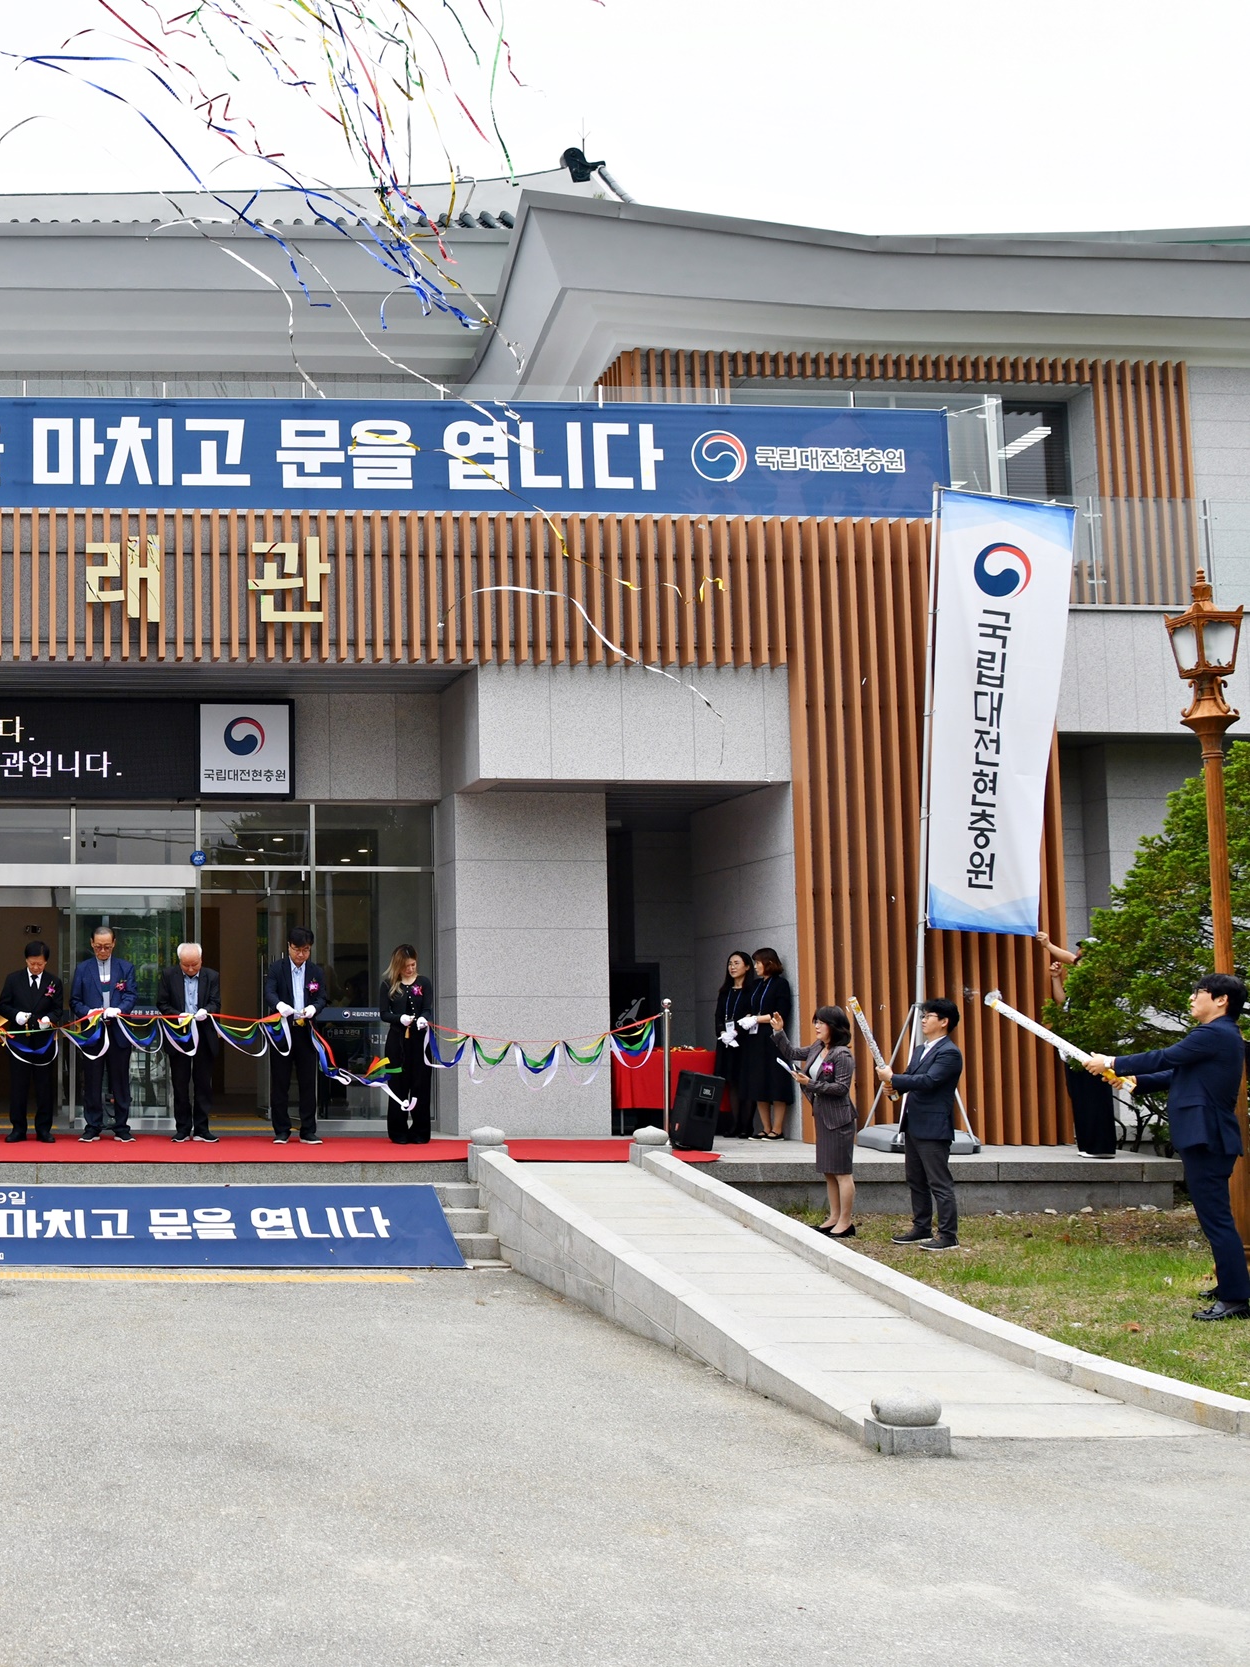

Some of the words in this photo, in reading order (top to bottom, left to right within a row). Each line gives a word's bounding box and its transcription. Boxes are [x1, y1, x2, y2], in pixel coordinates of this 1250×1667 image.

[32, 415, 251, 488] 마치고
[276, 418, 418, 491] 문을
[443, 418, 665, 492] 엽니다
[754, 445, 906, 474] 국립대전현충원
[966, 608, 1012, 891] 국립대전현충원
[203, 768, 287, 783] 국립대전현충원
[148, 1206, 237, 1241] 문을
[250, 1205, 391, 1241] 엽니다
